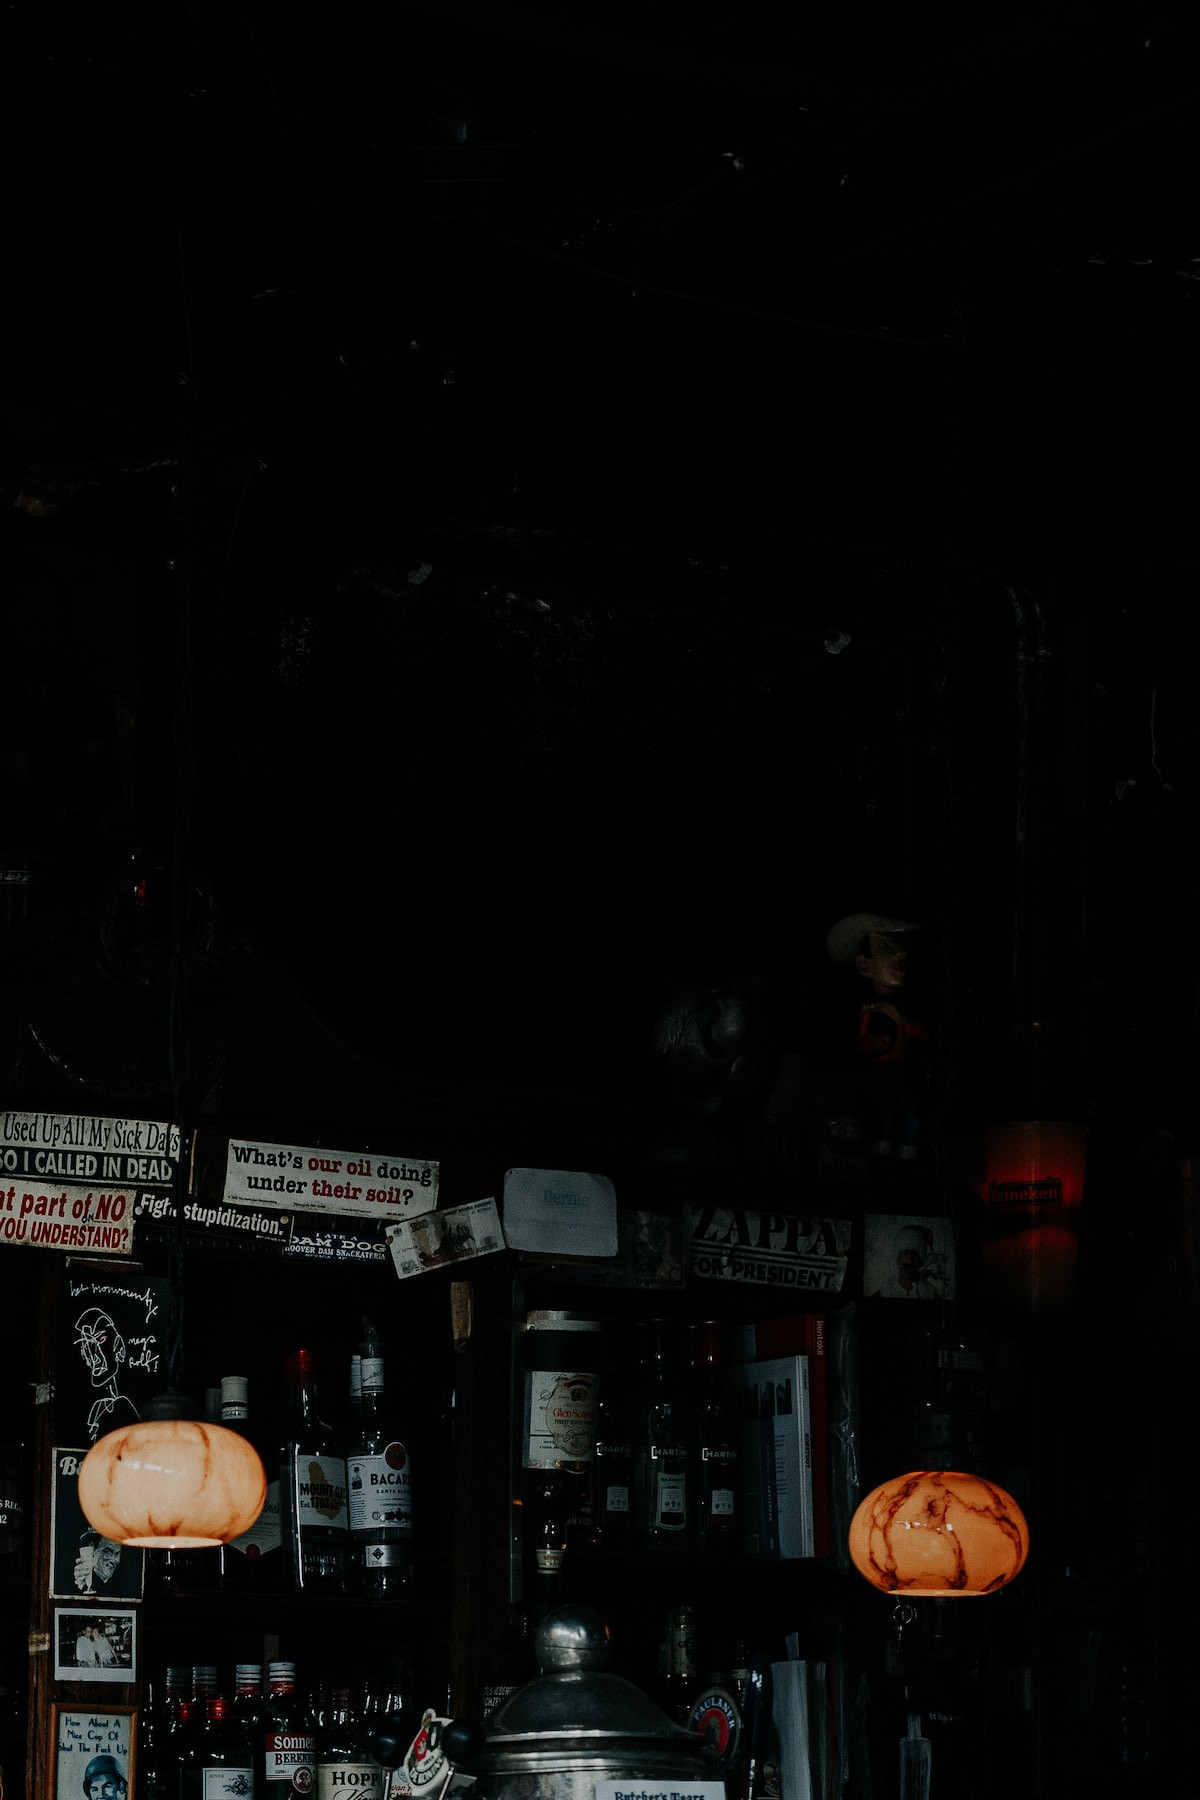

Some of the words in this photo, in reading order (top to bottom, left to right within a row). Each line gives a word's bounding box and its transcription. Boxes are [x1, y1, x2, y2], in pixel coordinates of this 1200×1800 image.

[4, 1116, 37, 1142] Used
[42, 1116, 61, 1146] Up
[63, 1118, 85, 1143] All
[90, 1120, 111, 1150] My
[113, 1123, 142, 1150] Sick
[24, 1151, 29, 1170] I
[34, 1152, 97, 1176] CALLED
[103, 1155, 122, 1177] IN
[126, 1158, 173, 1181] DEAD
[232, 1146, 303, 1170] What's
[308, 1156, 343, 1174] our
[347, 1157, 372, 1177] oil
[377, 1162, 432, 1187] doing
[247, 1174, 308, 1194] under
[312, 1179, 363, 1201] their
[366, 1187, 414, 1205] soil?
[21, 1190, 67, 1222] part
[72, 1191, 93, 1219] of
[95, 1194, 126, 1222] NO
[184, 1203, 283, 1236] stupidization.
[30, 1219, 129, 1250] UNDERSTAND?
[341, 1240, 386, 1252] DOG
[691, 1208, 838, 1257] ZAPPA
[691, 1257, 723, 1276] FOR
[730, 1260, 836, 1289] PRESIDENT
[816, 1320, 824, 1355] Rentokil
[300, 1483, 334, 1497] MOUNT
[65, 1717, 80, 1726] How
[88, 1717, 109, 1727] About
[114, 1719, 120, 1728] A
[694, 1697, 735, 1728] PAULANER
[67, 1730, 82, 1739] Nice
[88, 1730, 103, 1741] Cup
[108, 1731, 118, 1740] Of
[78, 1743, 90, 1752] The
[96, 1744, 111, 1753] Fuck
[117, 1744, 127, 1755] Up
